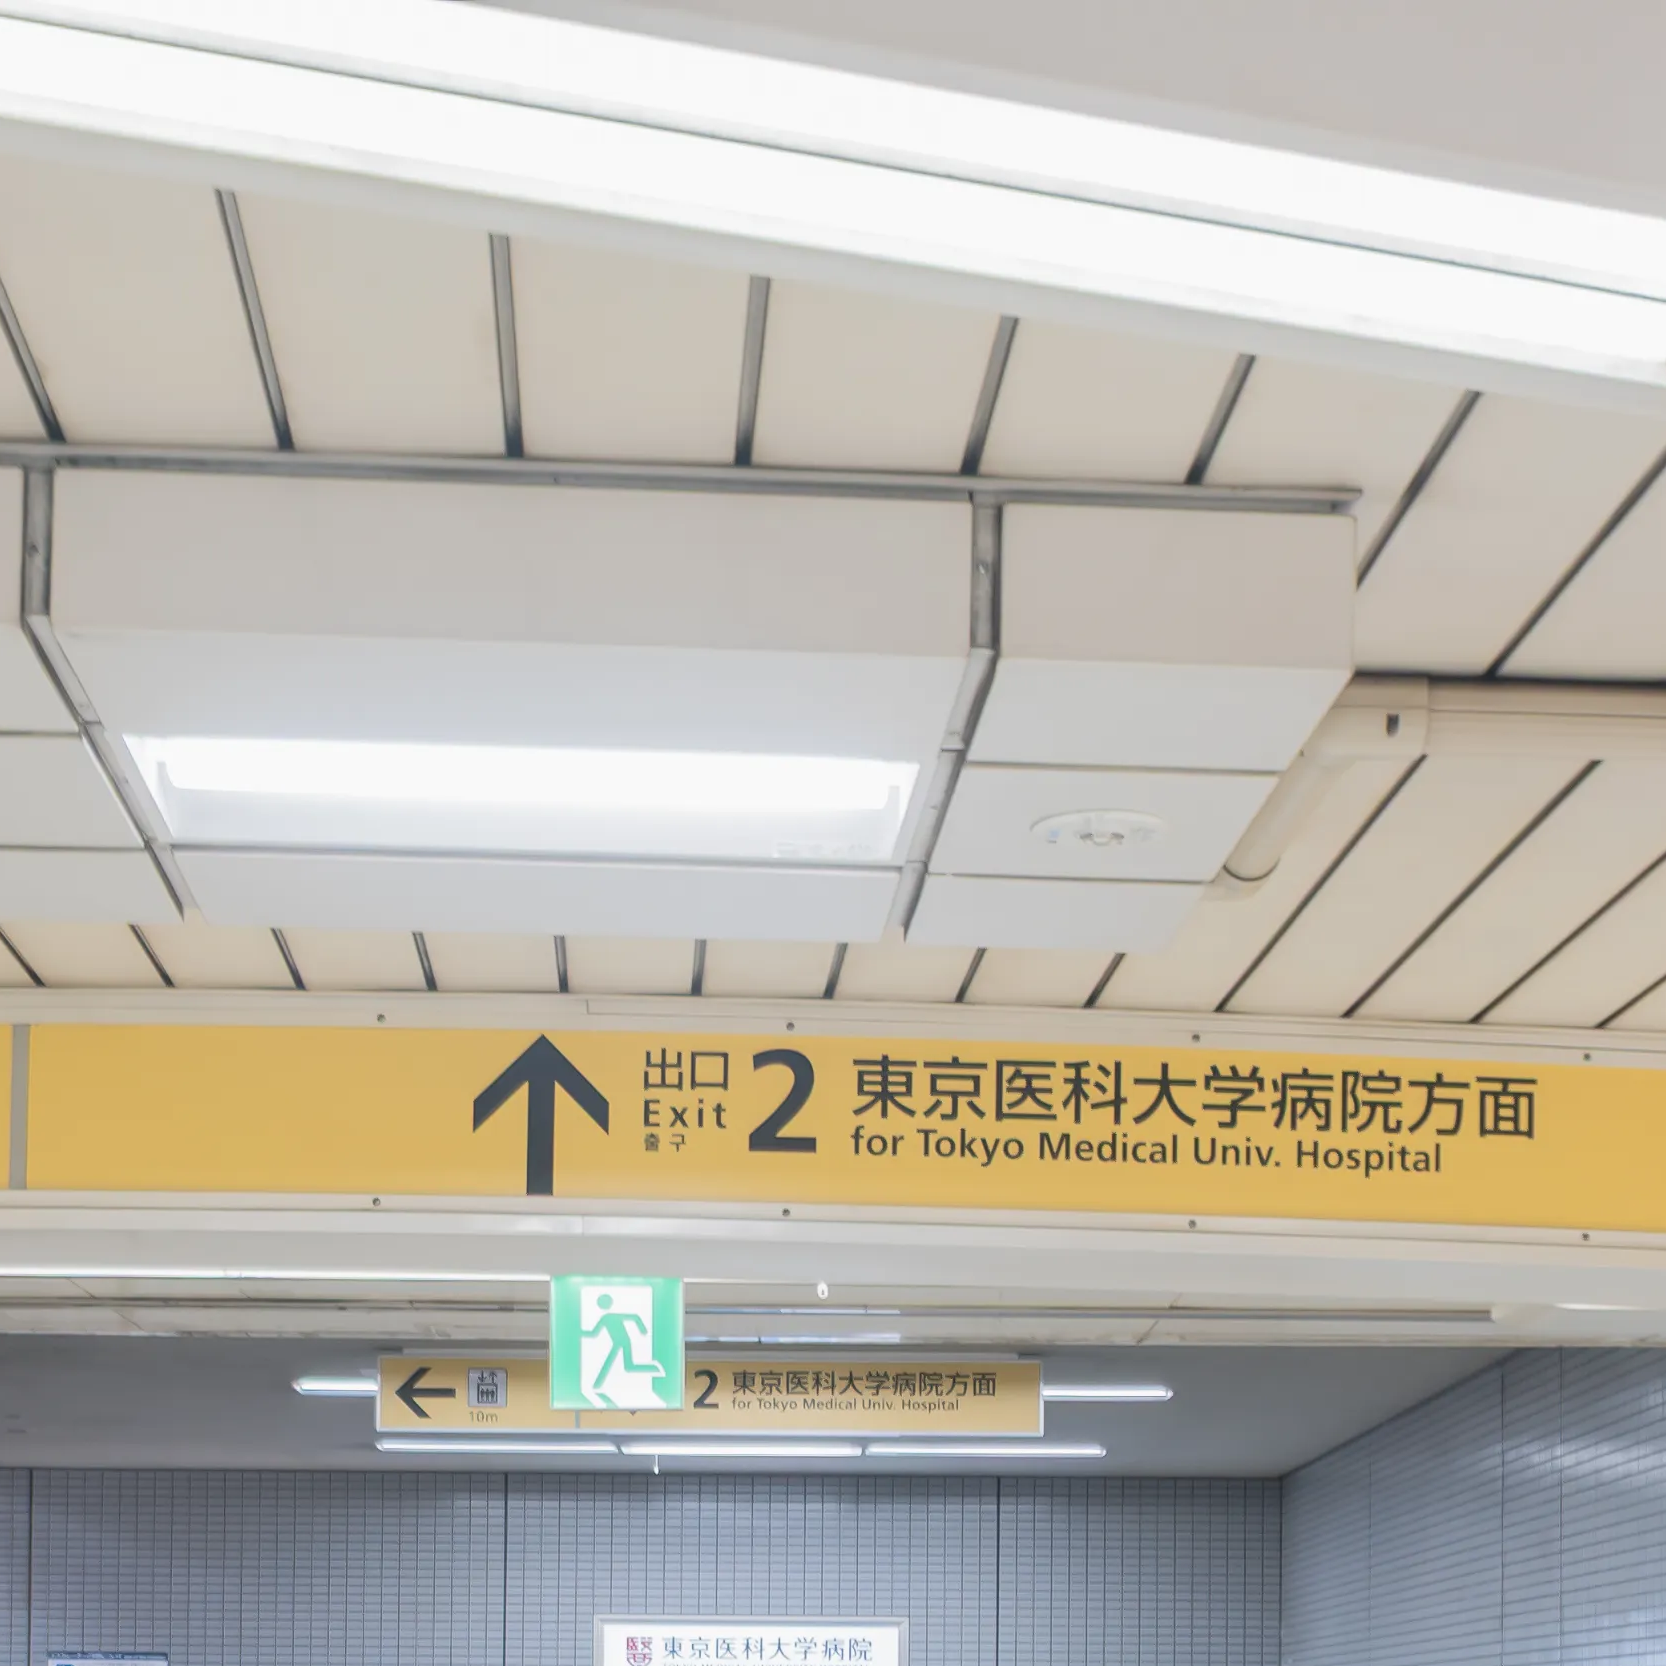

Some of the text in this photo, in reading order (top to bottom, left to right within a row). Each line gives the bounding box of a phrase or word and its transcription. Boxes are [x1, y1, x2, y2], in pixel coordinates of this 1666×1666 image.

[643, 1047, 729, 1092] 出口
[643, 1098, 727, 1129] Exit
[748, 1048, 818, 1154] 2
[852, 1053, 1538, 1140] 東京医科大学病院方面
[850, 1124, 1442, 1180] for Tokyo Medical Univ. Hospital
[693, 1368, 720, 1410] 2
[732, 1369, 997, 1398] 東京医科大学病院方面
[468, 1410, 499, 1423] 10m
[732, 1397, 960, 1414] for Tokyo Medical Univ. Hospital
[662, 1636, 873, 1662] 東京医科大学病院
